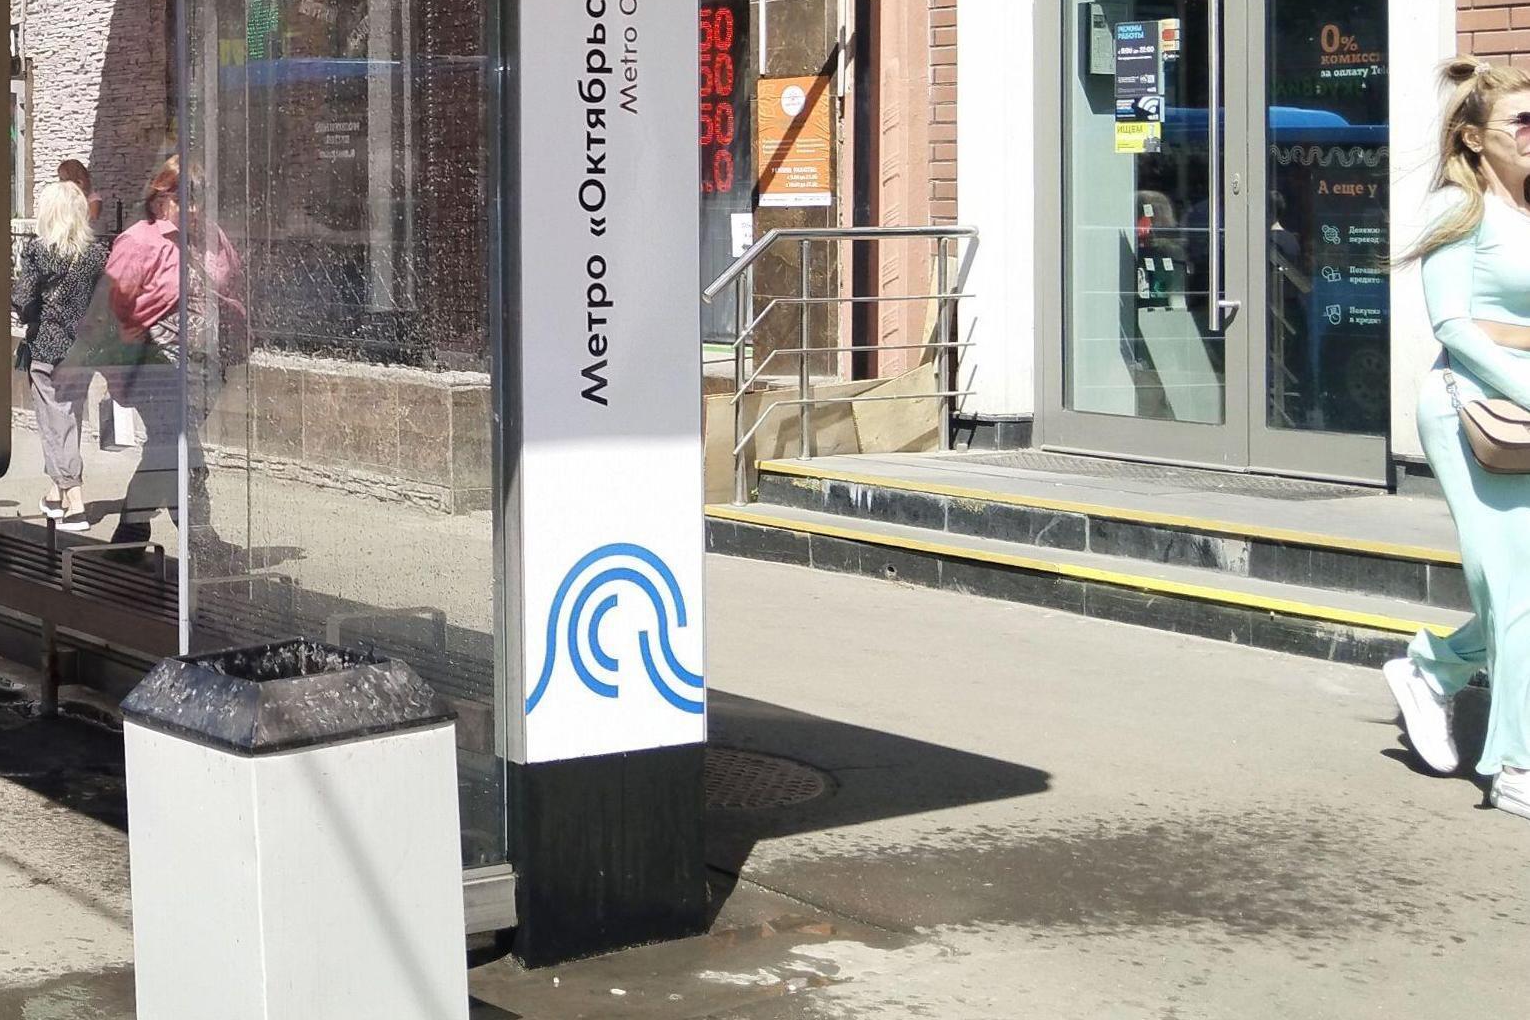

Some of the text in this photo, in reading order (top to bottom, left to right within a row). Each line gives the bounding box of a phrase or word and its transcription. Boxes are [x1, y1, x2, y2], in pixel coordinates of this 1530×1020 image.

[1320, 23, 1359, 53] 0%
[620, 27, 638, 114] Metro
[1333, 66, 1369, 80] оплату
[1318, 180, 1378, 198] А еще у
[581, 255, 614, 406] Метро
